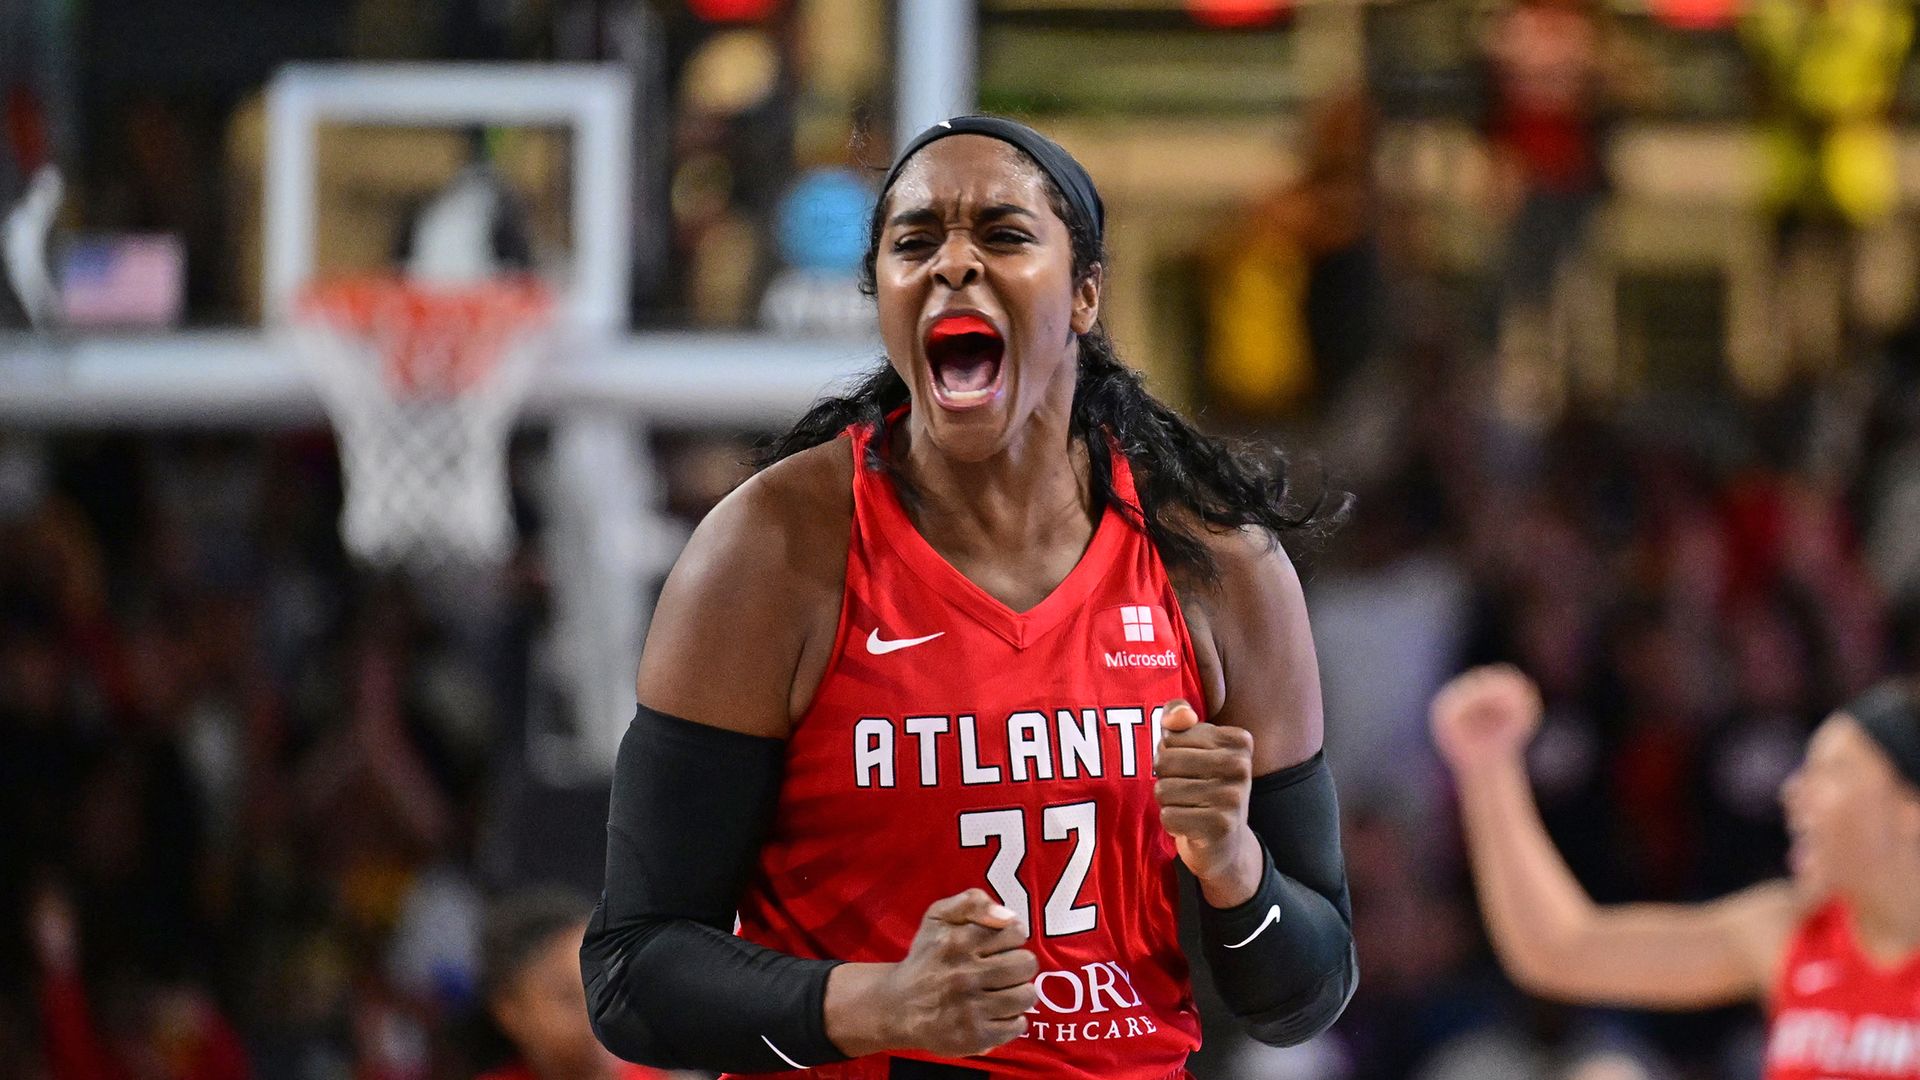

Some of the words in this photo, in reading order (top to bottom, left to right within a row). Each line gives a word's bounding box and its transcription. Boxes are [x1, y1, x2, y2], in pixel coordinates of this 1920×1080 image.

[1104, 650, 1177, 668] Microsoft
[959, 800, 1097, 938] 32
[1025, 961, 1142, 1014] ORY
